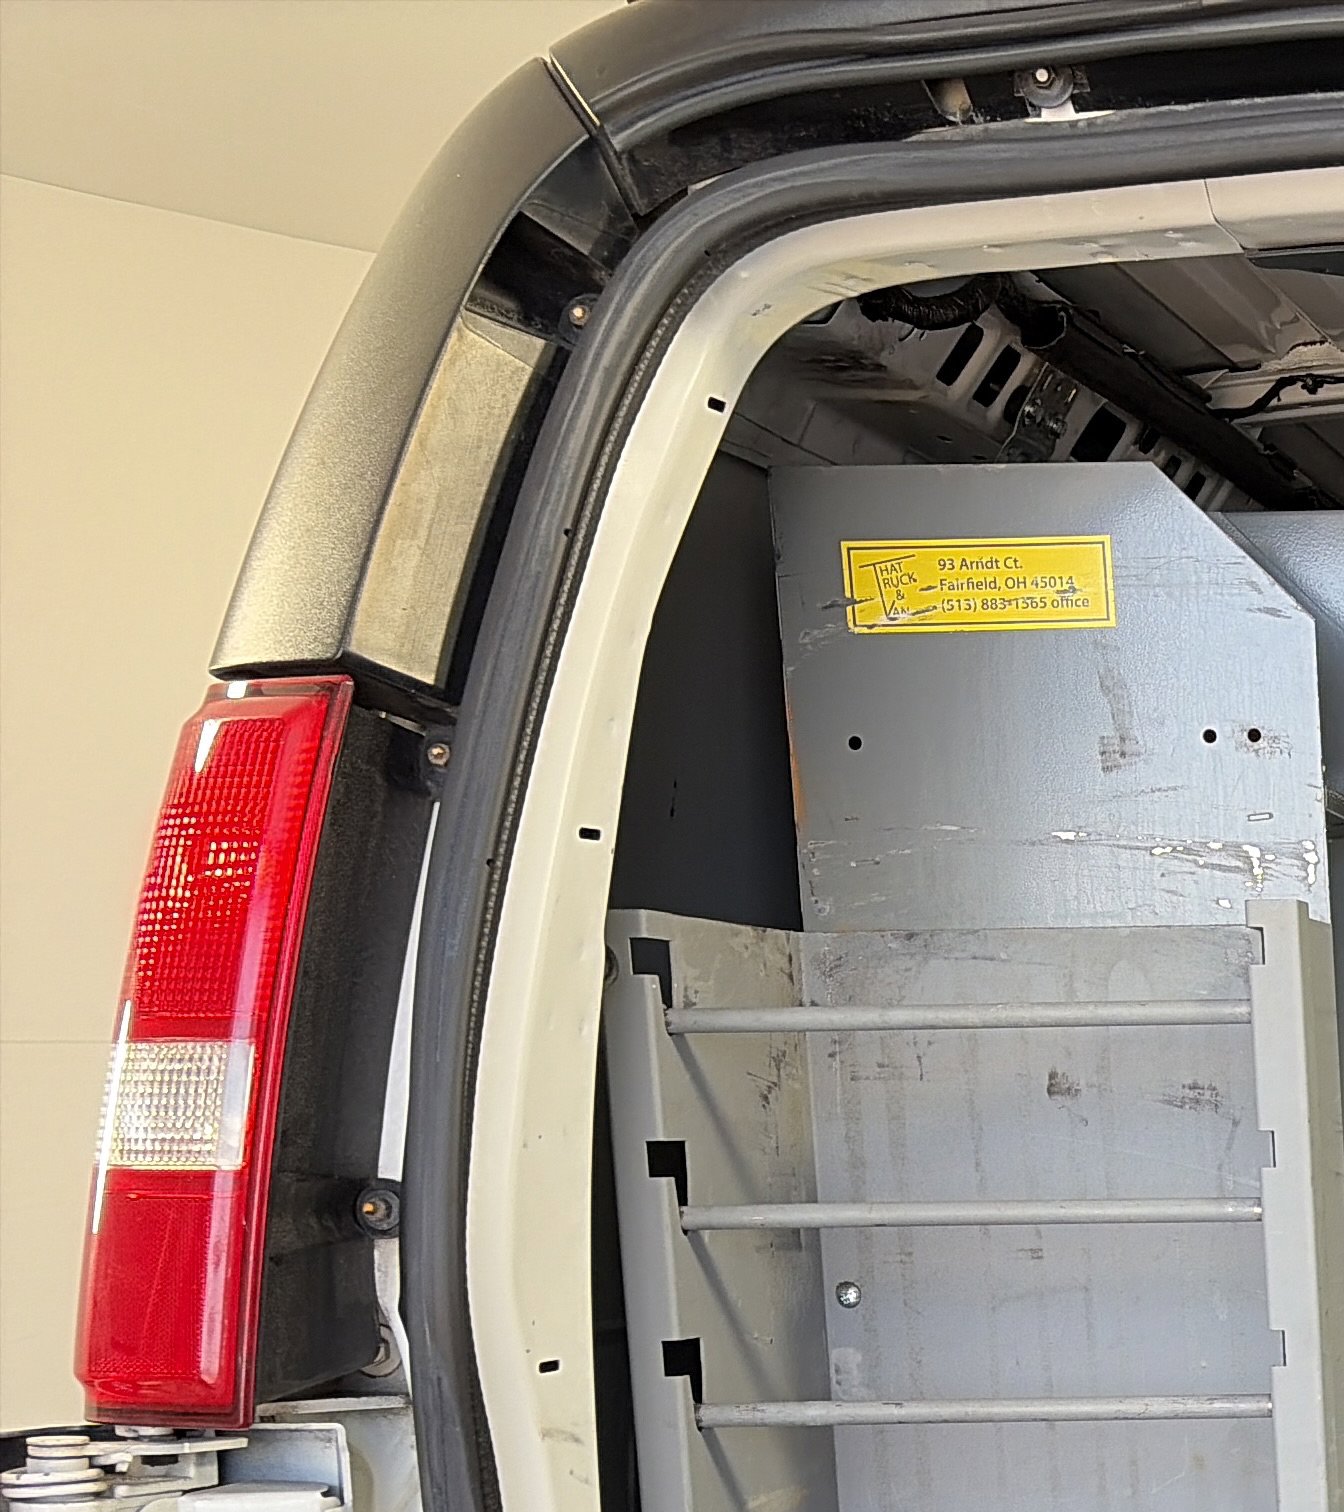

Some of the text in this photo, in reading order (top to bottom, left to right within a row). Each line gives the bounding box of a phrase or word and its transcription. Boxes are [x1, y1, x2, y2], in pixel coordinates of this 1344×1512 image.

[938, 556, 1023, 571] 93 Arndt Ct.
[939, 575, 1074, 591] Fairfield, OH 45014
[896, 589, 905, 601] &
[1051, 595, 1089, 609] office
